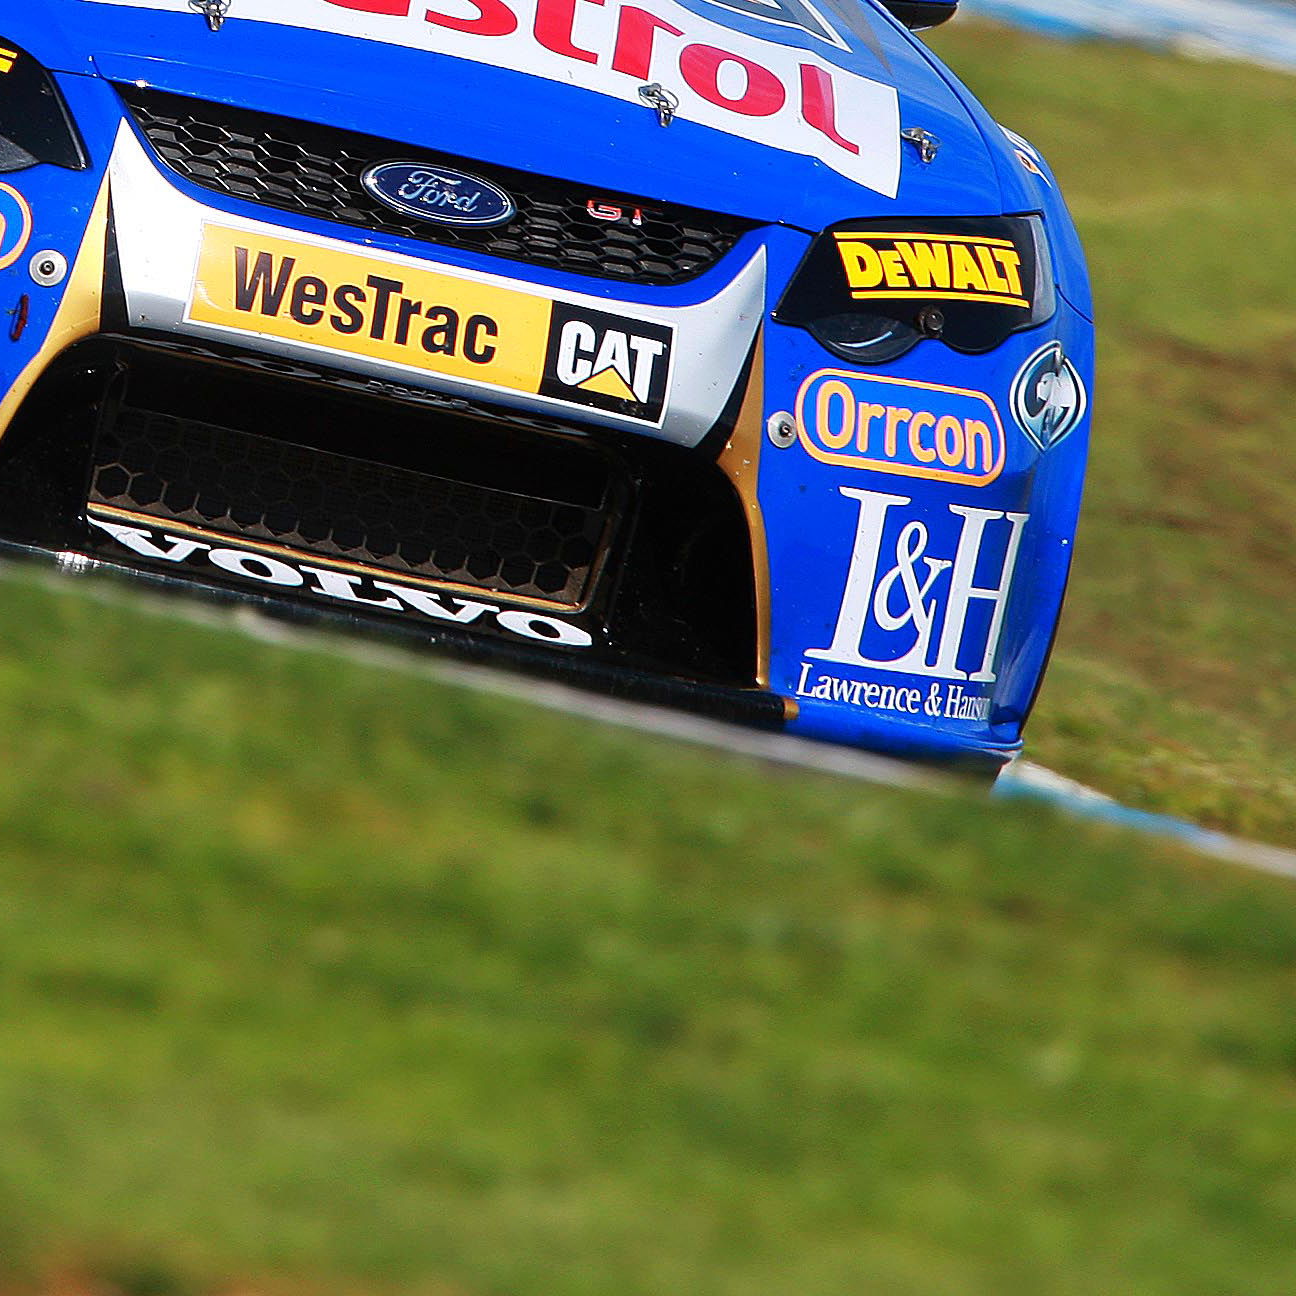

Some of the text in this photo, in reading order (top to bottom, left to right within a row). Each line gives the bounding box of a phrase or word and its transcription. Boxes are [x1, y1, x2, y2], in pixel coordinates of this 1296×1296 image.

[401, 171, 479, 214] Ford
[234, 244, 499, 364] WesTrac
[556, 318, 664, 404] CAT
[816, 387, 994, 474] Orrcon
[86, 515, 593, 647] VOLVO
[804, 487, 1030, 683] L&H
[796, 662, 921, 714] Lawrence
[924, 683, 943, 717] &
